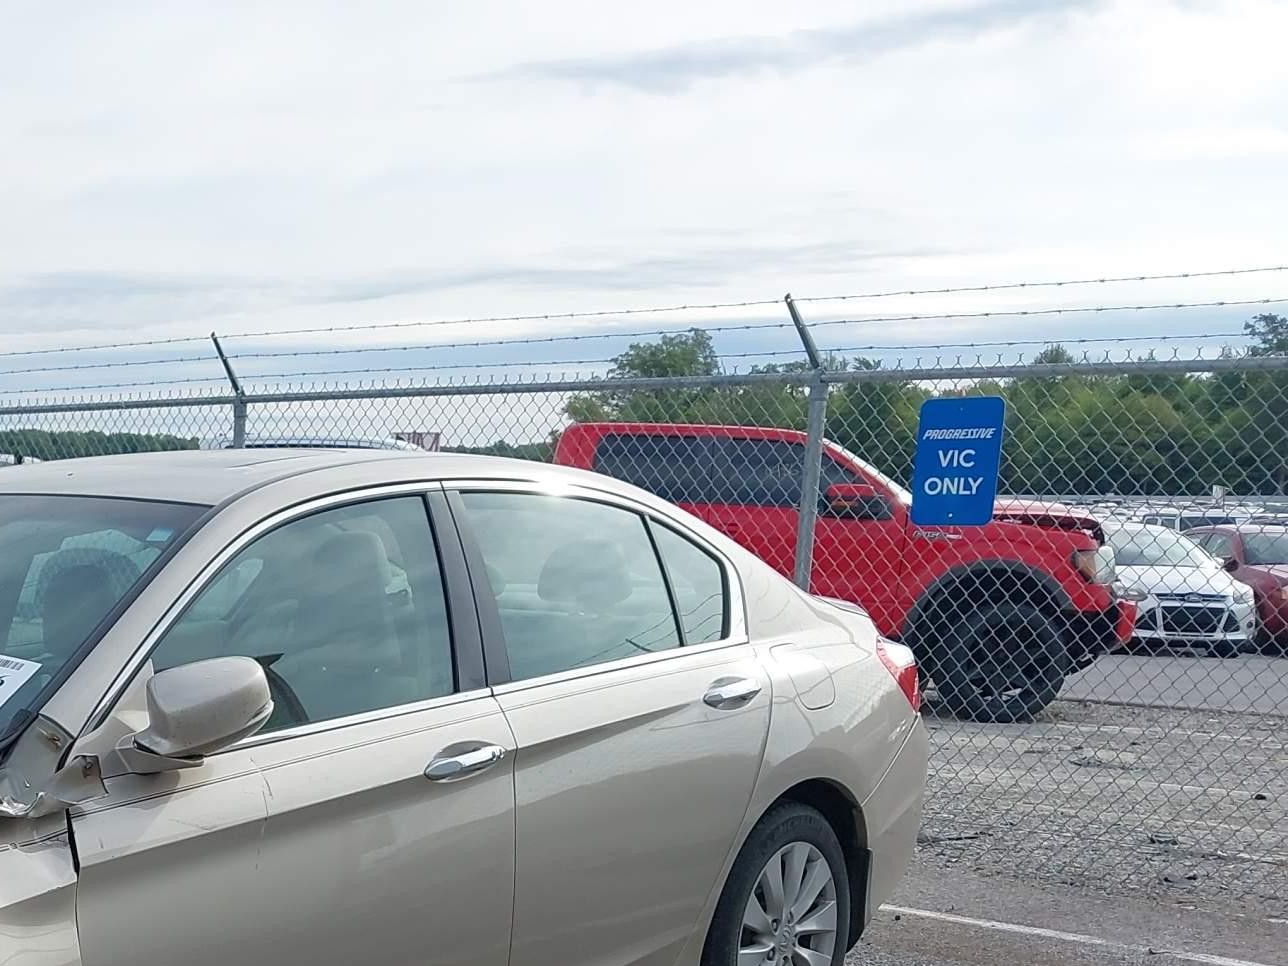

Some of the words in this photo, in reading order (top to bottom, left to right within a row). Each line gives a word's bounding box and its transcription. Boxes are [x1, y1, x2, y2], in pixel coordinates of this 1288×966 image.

[923, 428, 996, 440] PROGRESSIVE
[938, 449, 976, 468] VIC
[924, 477, 984, 496] ONLY
